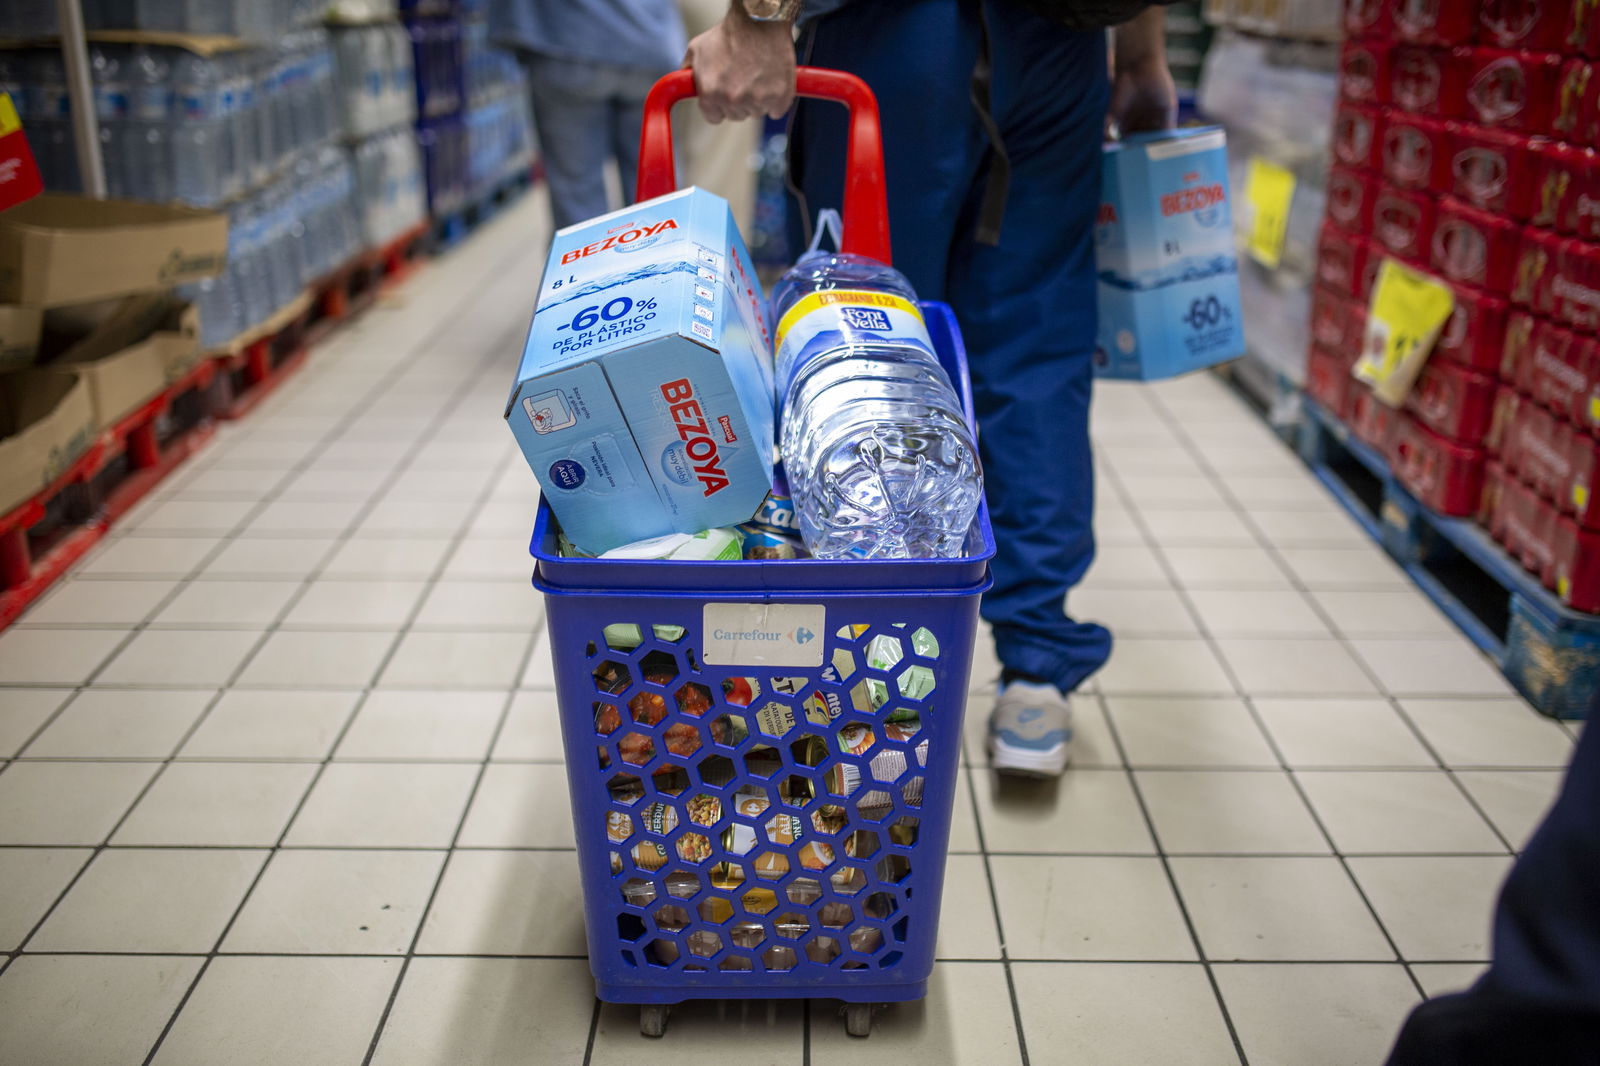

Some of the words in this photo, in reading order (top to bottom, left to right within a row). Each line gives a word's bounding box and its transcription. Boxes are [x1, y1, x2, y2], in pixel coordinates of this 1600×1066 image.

[1160, 184, 1227, 218] BEZOYA
[561, 219, 678, 265] BEZOYA
[552, 279, 563, 290] 8
[569, 274, 578, 284] L
[556, 296, 657, 332] -60%
[845, 308, 884, 321] Font
[848, 318, 889, 330] Vella
[552, 336, 573, 350] DE
[579, 312, 657, 341] PLÁSTICO
[560, 339, 593, 355] POR
[598, 323, 646, 343] LITRO
[573, 387, 583, 399] Saca
[582, 405, 591, 419] grifo
[660, 378, 730, 498] BEZOYA
[720, 416, 736, 442] Pascual
[557, 465, 573, 485] AQUÍ
[591, 456, 603, 477] NEVERA
[592, 441, 604, 462] Posición
[601, 462, 610, 475] ideal
[607, 475, 616, 487] para
[667, 449, 679, 465] muy
[675, 464, 688, 485] débil
[713, 628, 781, 641] Carrefour
